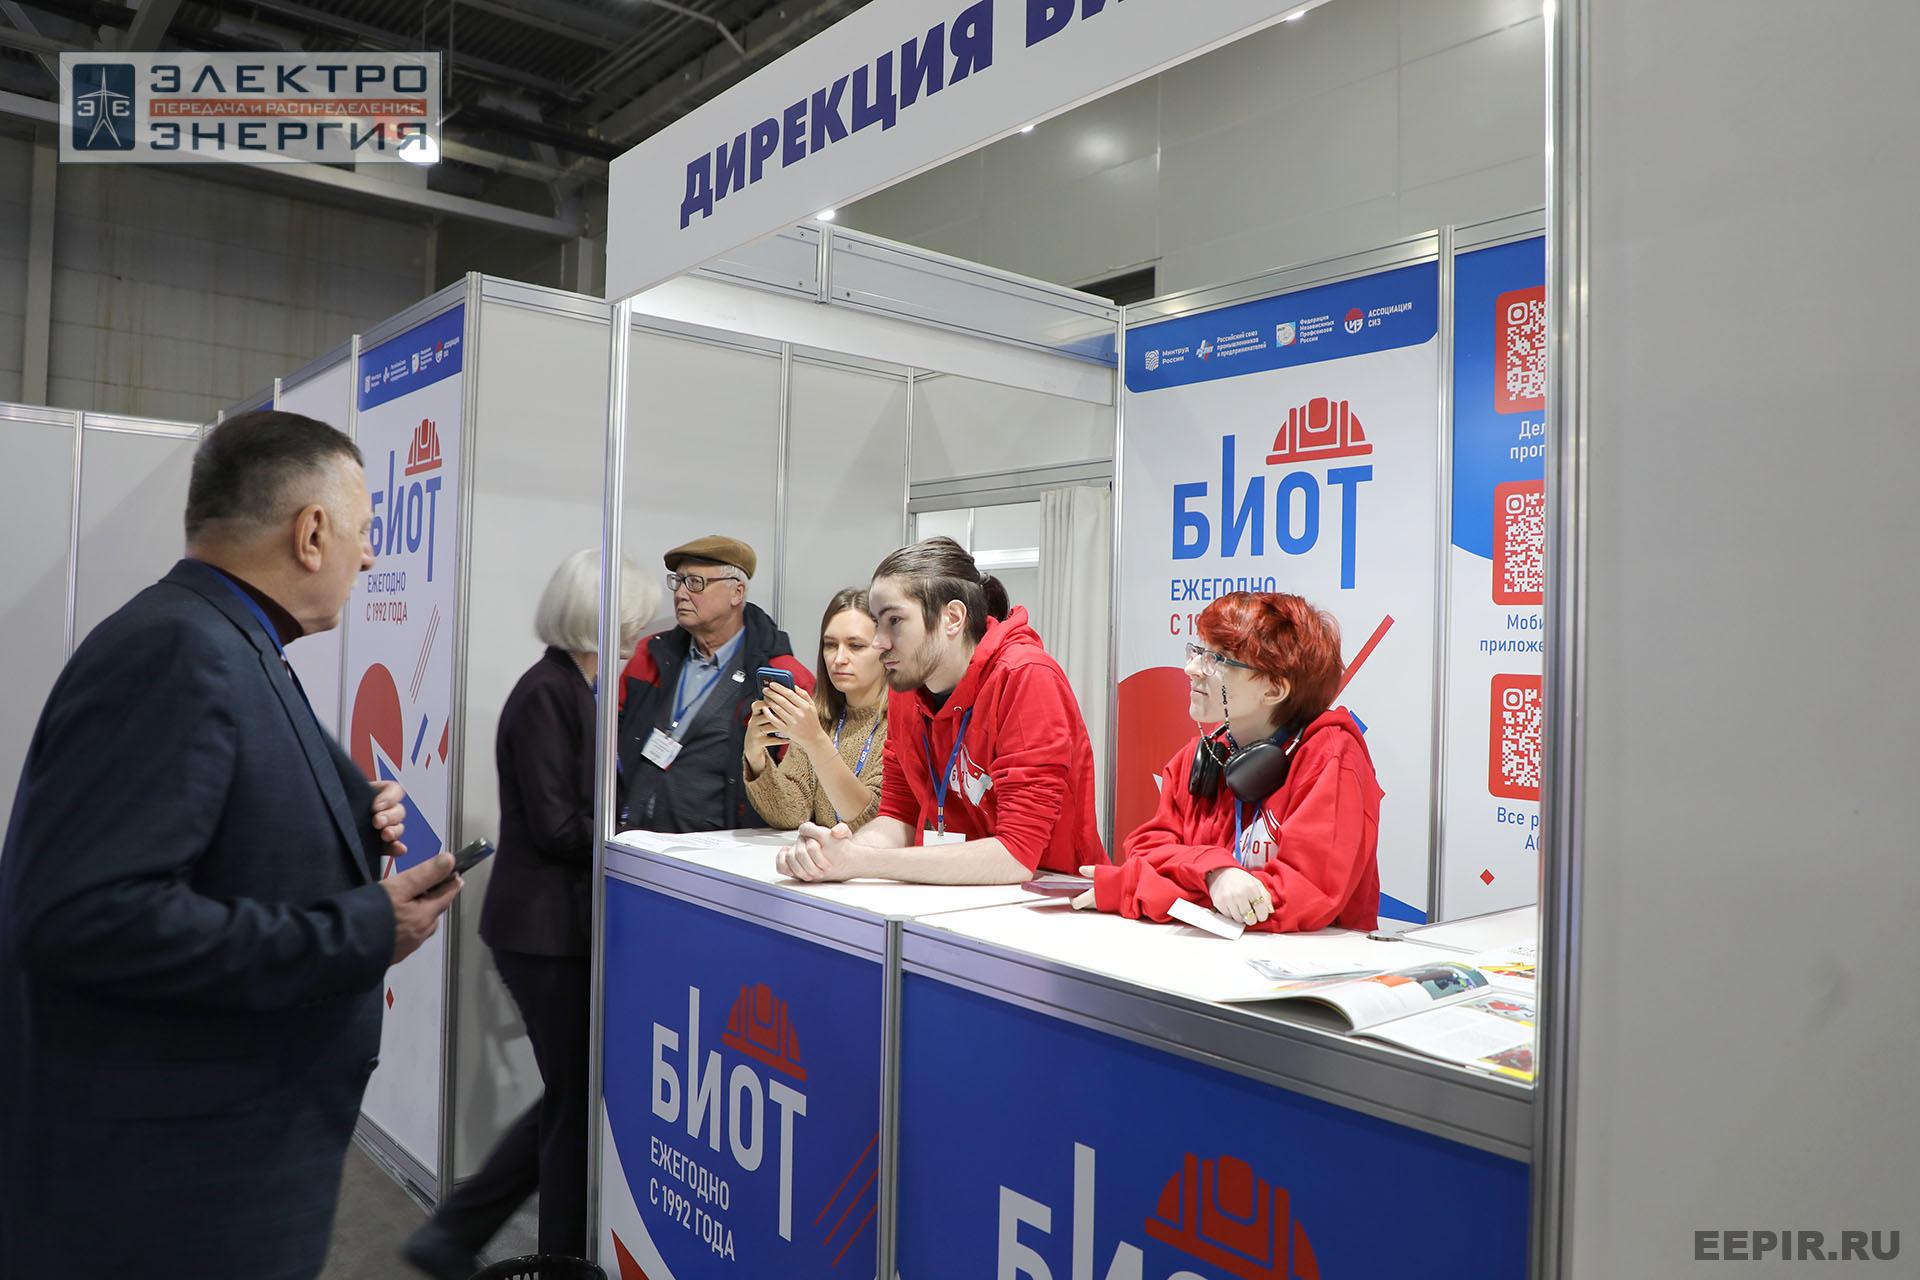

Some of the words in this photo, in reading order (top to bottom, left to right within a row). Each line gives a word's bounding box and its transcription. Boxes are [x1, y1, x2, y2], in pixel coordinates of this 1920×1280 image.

[680, 0, 994, 230] ДИРЕКЦИЯ
[1368, 302, 1412, 318] АССОЦИАЦИЯ
[1368, 318, 1381, 328] СИЗ
[1162, 346, 1190, 357] Минтруд
[1162, 356, 1185, 365] России
[370, 450, 442, 582] БИОТ
[1171, 434, 1373, 590] БИОТ
[367, 571, 407, 596] ЕЖЕГОДНО
[372, 601, 386, 622] 1992
[388, 602, 408, 625] ГОДА
[1170, 613, 1181, 635] С
[1497, 806, 1525, 825] Все
[652, 985, 806, 1242] БИОТ
[650, 1135, 730, 1211] ЕЖЕГОДНО
[650, 1177, 659, 1205] С
[662, 1184, 691, 1230] 1992
[695, 1208, 735, 1262] ГОДА
